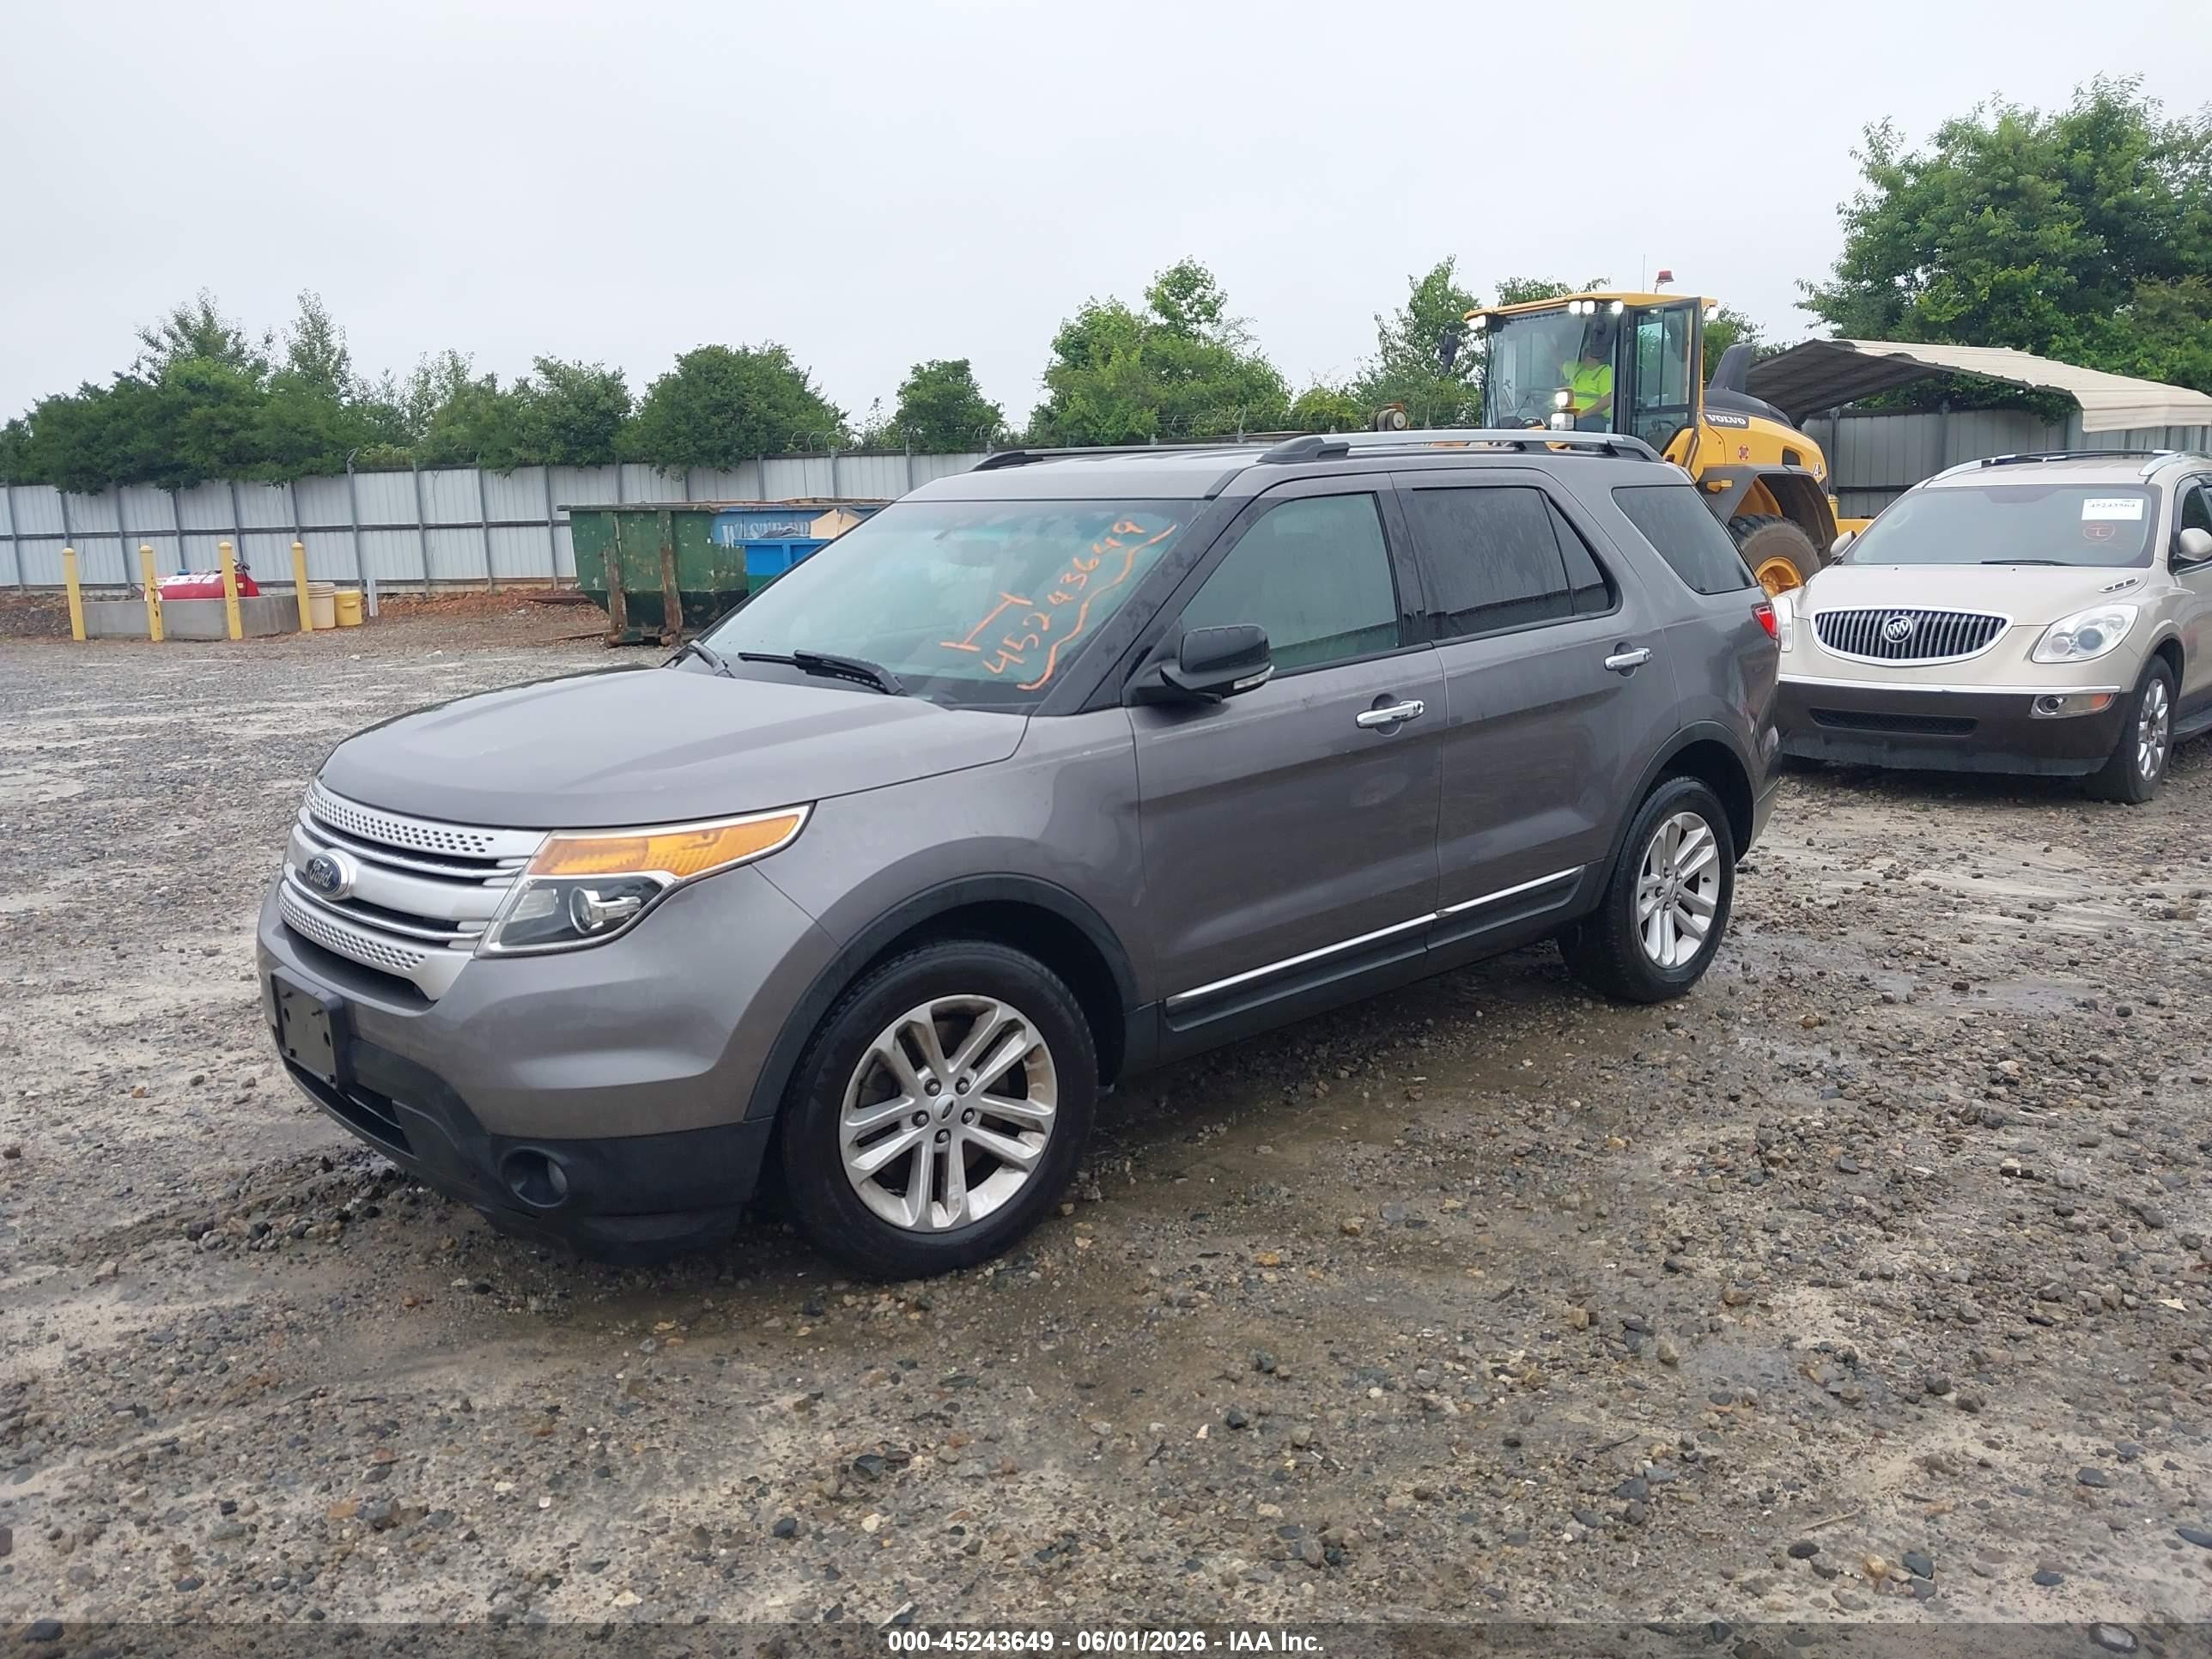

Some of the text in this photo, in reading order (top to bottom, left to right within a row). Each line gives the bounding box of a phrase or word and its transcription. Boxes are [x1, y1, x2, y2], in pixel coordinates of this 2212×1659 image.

[1705, 414, 1747, 425] VOLVO
[981, 520, 1146, 674] 45243649
[309, 858, 334, 888] Ford
